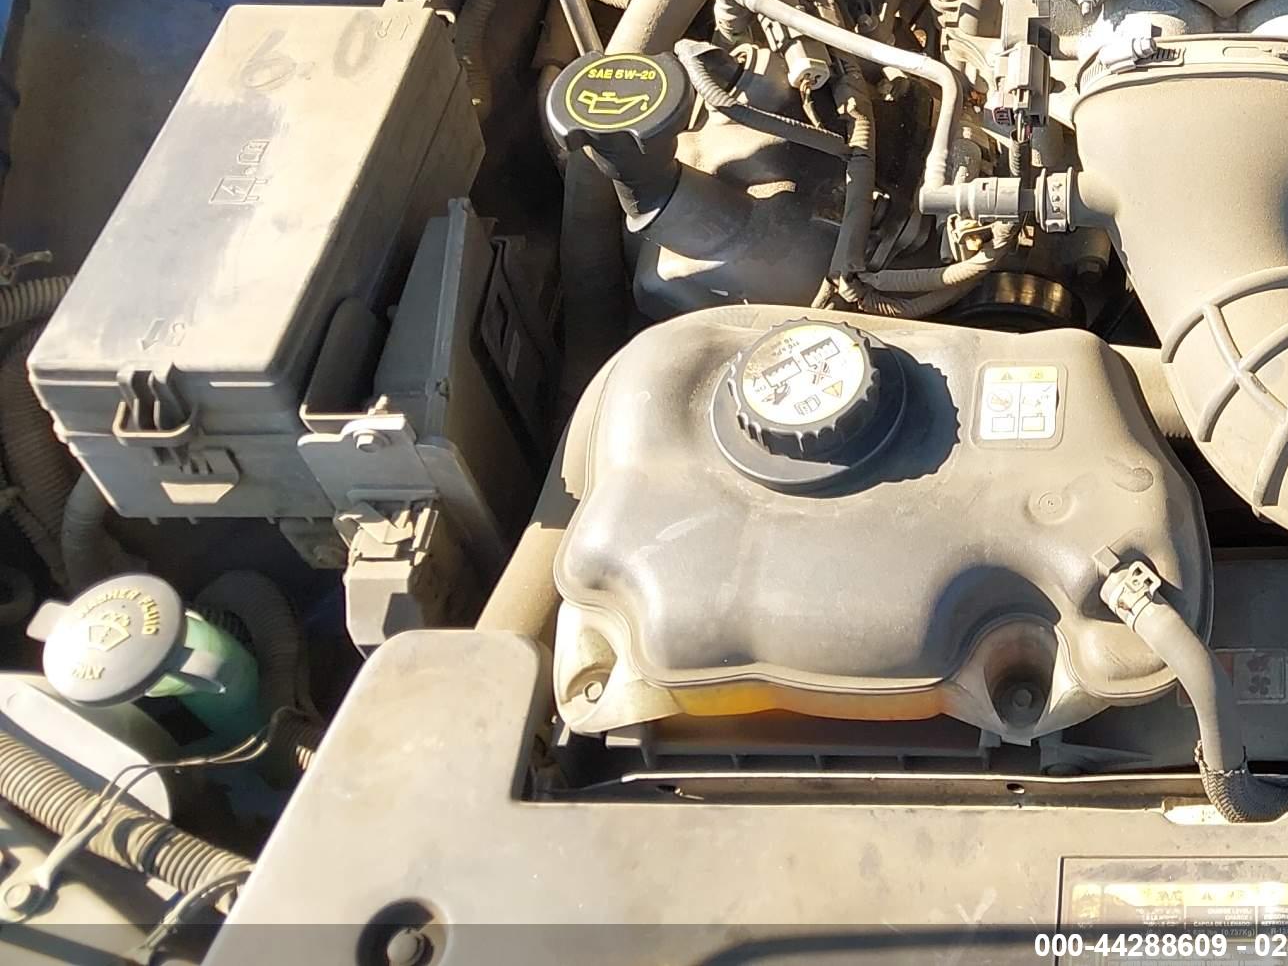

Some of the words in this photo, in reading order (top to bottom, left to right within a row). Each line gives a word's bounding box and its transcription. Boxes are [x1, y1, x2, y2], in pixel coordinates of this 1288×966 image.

[588, 68, 613, 79] SAE
[615, 69, 657, 80] 5W-20
[139, 595, 160, 635] FLUID
